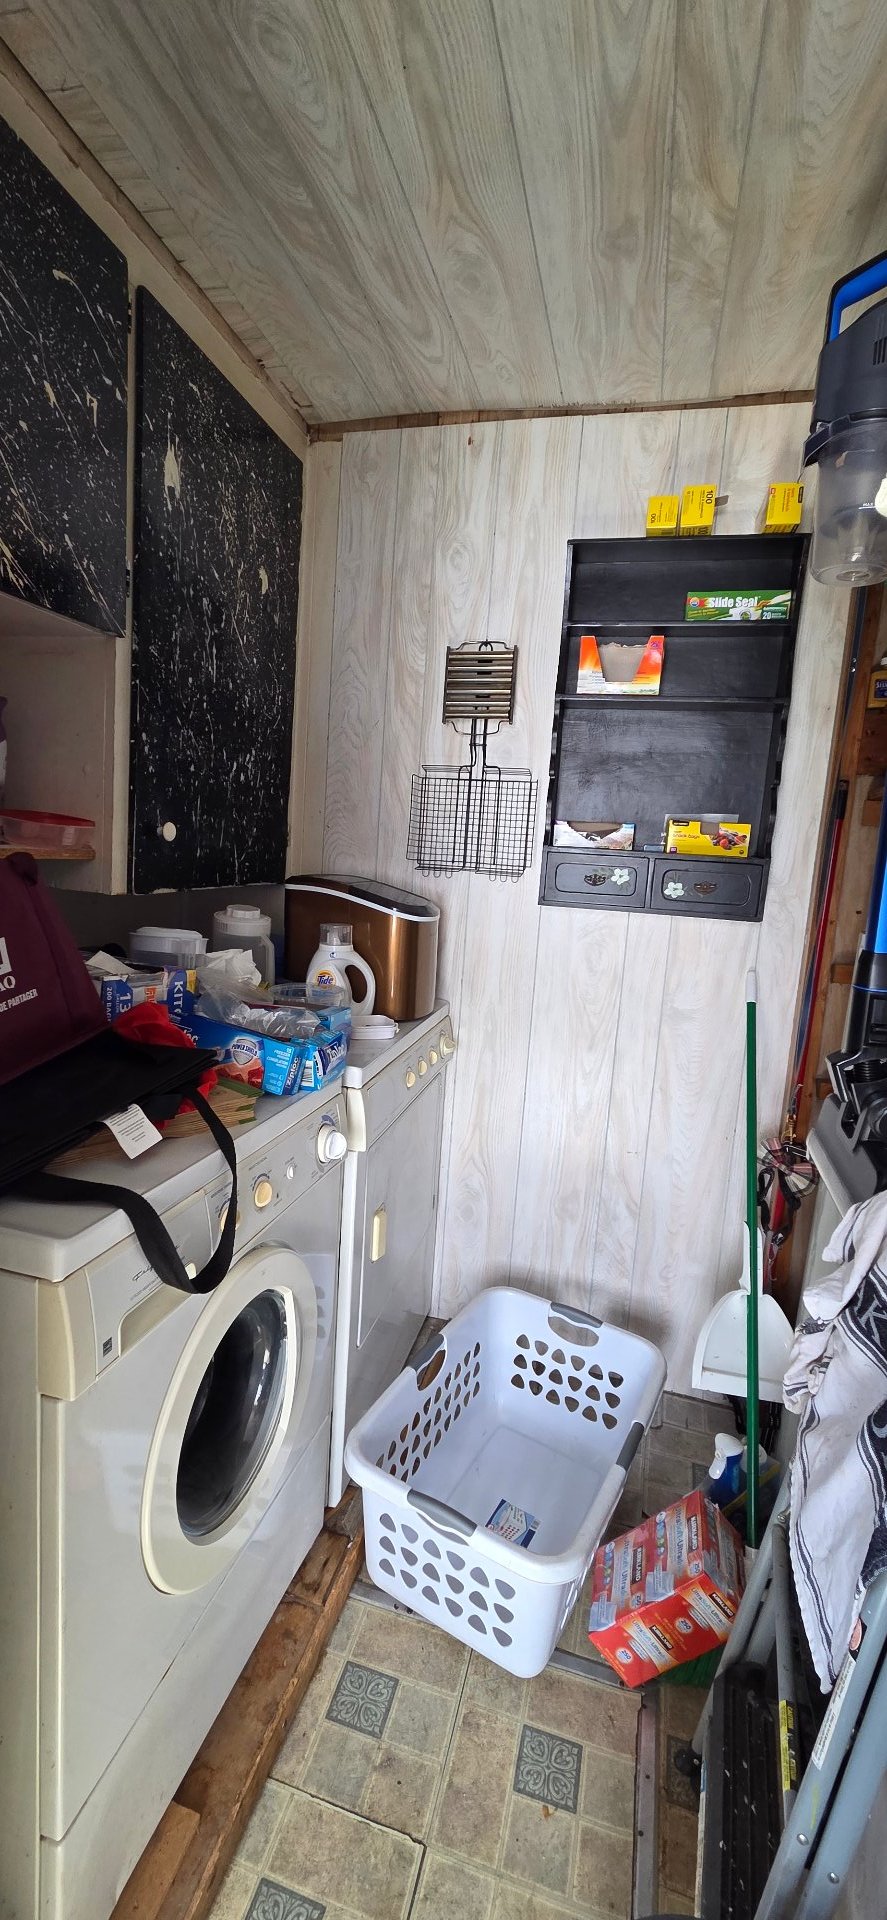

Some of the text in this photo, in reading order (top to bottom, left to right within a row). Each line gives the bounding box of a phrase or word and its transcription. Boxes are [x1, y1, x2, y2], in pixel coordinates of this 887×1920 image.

[705, 489, 715, 505] 100
[709, 597, 759, 608] Slide Seal
[762, 612, 772, 620] 20
[318, 975, 334, 985] Tide
[8, 988, 39, 1008] PARTAGER
[120, 992, 131, 1013] 13
[287, 1057, 299, 1085] Ziploc
[690, 1516, 698, 1550] KIRKLAND
[635, 1548, 643, 1582] KIRKLAND
[711, 1593, 734, 1616] KIRKLAND
[680, 1619, 692, 1630] 250
[650, 1625, 673, 1649] KIRKLAND
[621, 1649, 632, 1660] 250
